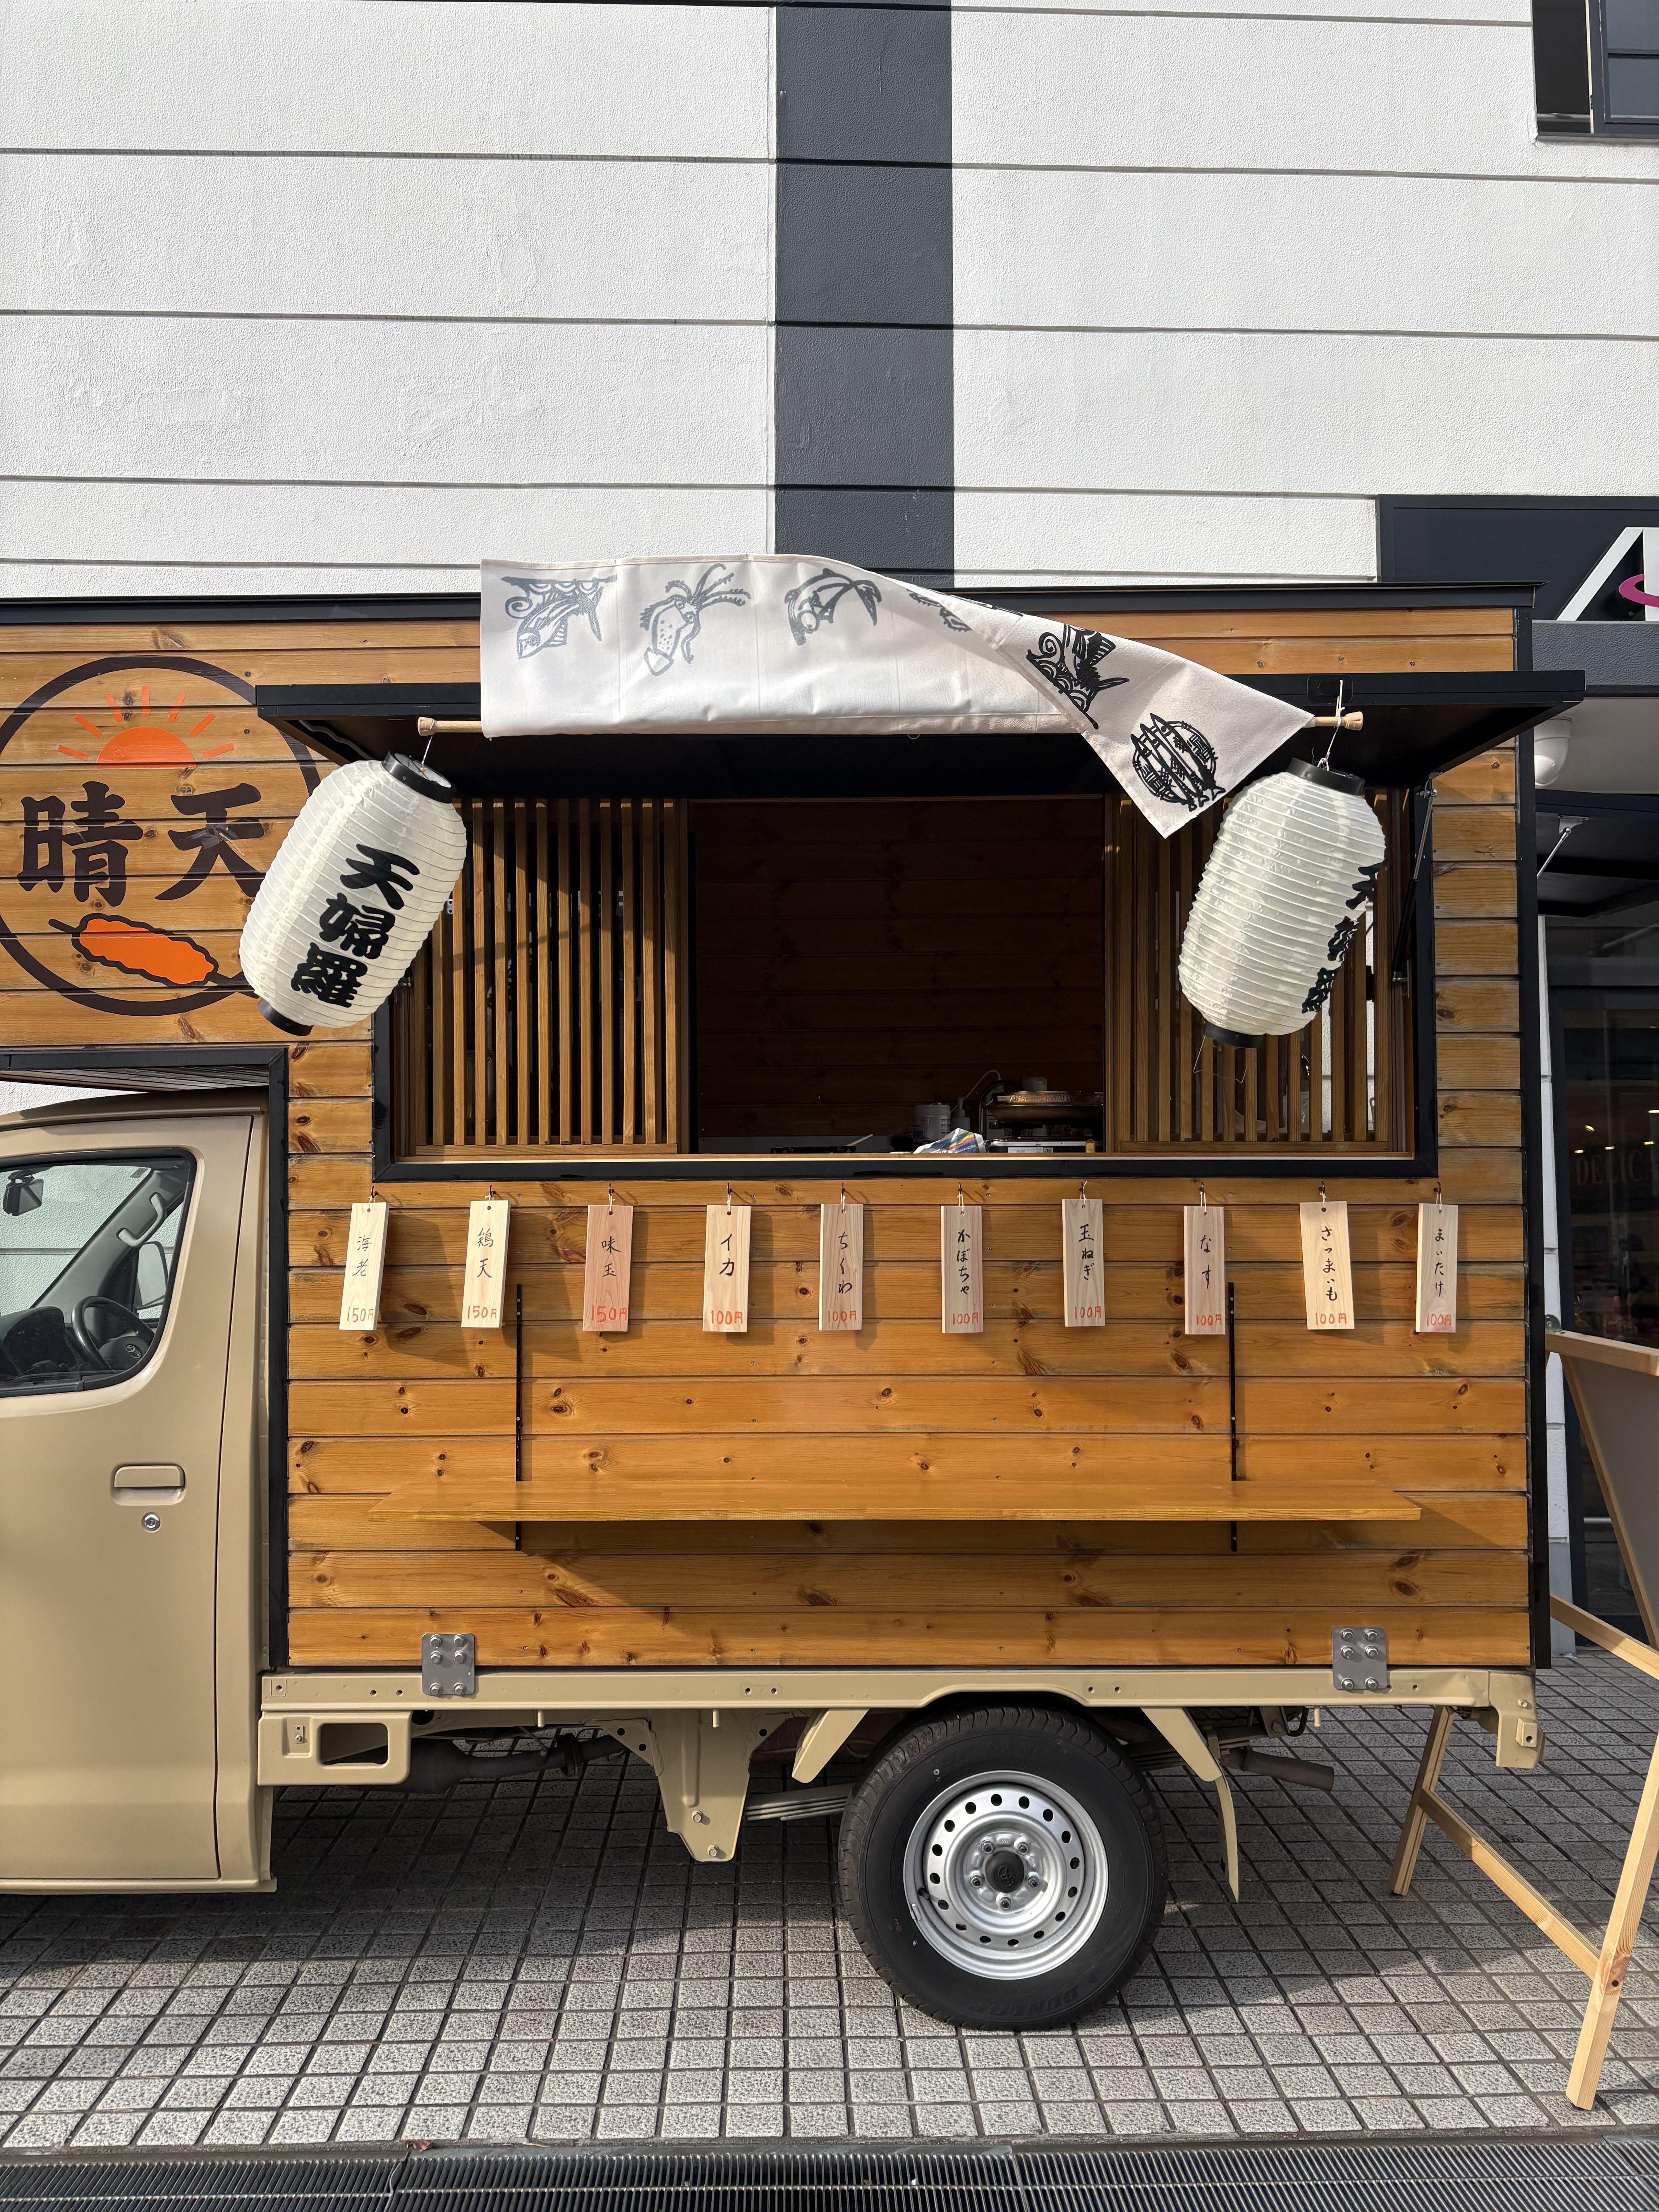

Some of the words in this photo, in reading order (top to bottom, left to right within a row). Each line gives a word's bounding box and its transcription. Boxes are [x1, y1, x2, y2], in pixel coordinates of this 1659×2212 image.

[17, 780, 267, 907] 晴天
[290, 843, 420, 1008] 天婦羅
[352, 1235, 372, 1277] 海老
[601, 1236, 622, 1277] 味玉
[719, 1233, 735, 1276] イカ
[838, 1231, 852, 1295] ちくわ
[956, 1229, 971, 1295] かぼちゃ
[1078, 1223, 1095, 1281] 玉ねぎ
[1200, 1235, 1212, 1290] なす
[1321, 1226, 1338, 1301] さつまいも
[1434, 1227, 1444, 1298] まいたけ
[347, 1308, 374, 1322] 150円
[467, 1305, 497, 1319] 150円
[591, 1305, 627, 1323] 150円
[711, 1310, 743, 1325] 100円
[827, 1310, 857, 1323] 100円
[952, 1312, 979, 1325] 100円
[1074, 1305, 1102, 1320] 100円
[1195, 1314, 1222, 1326] 100円
[1315, 1312, 1347, 1326] 100円
[1426, 1312, 1451, 1326] 100円
